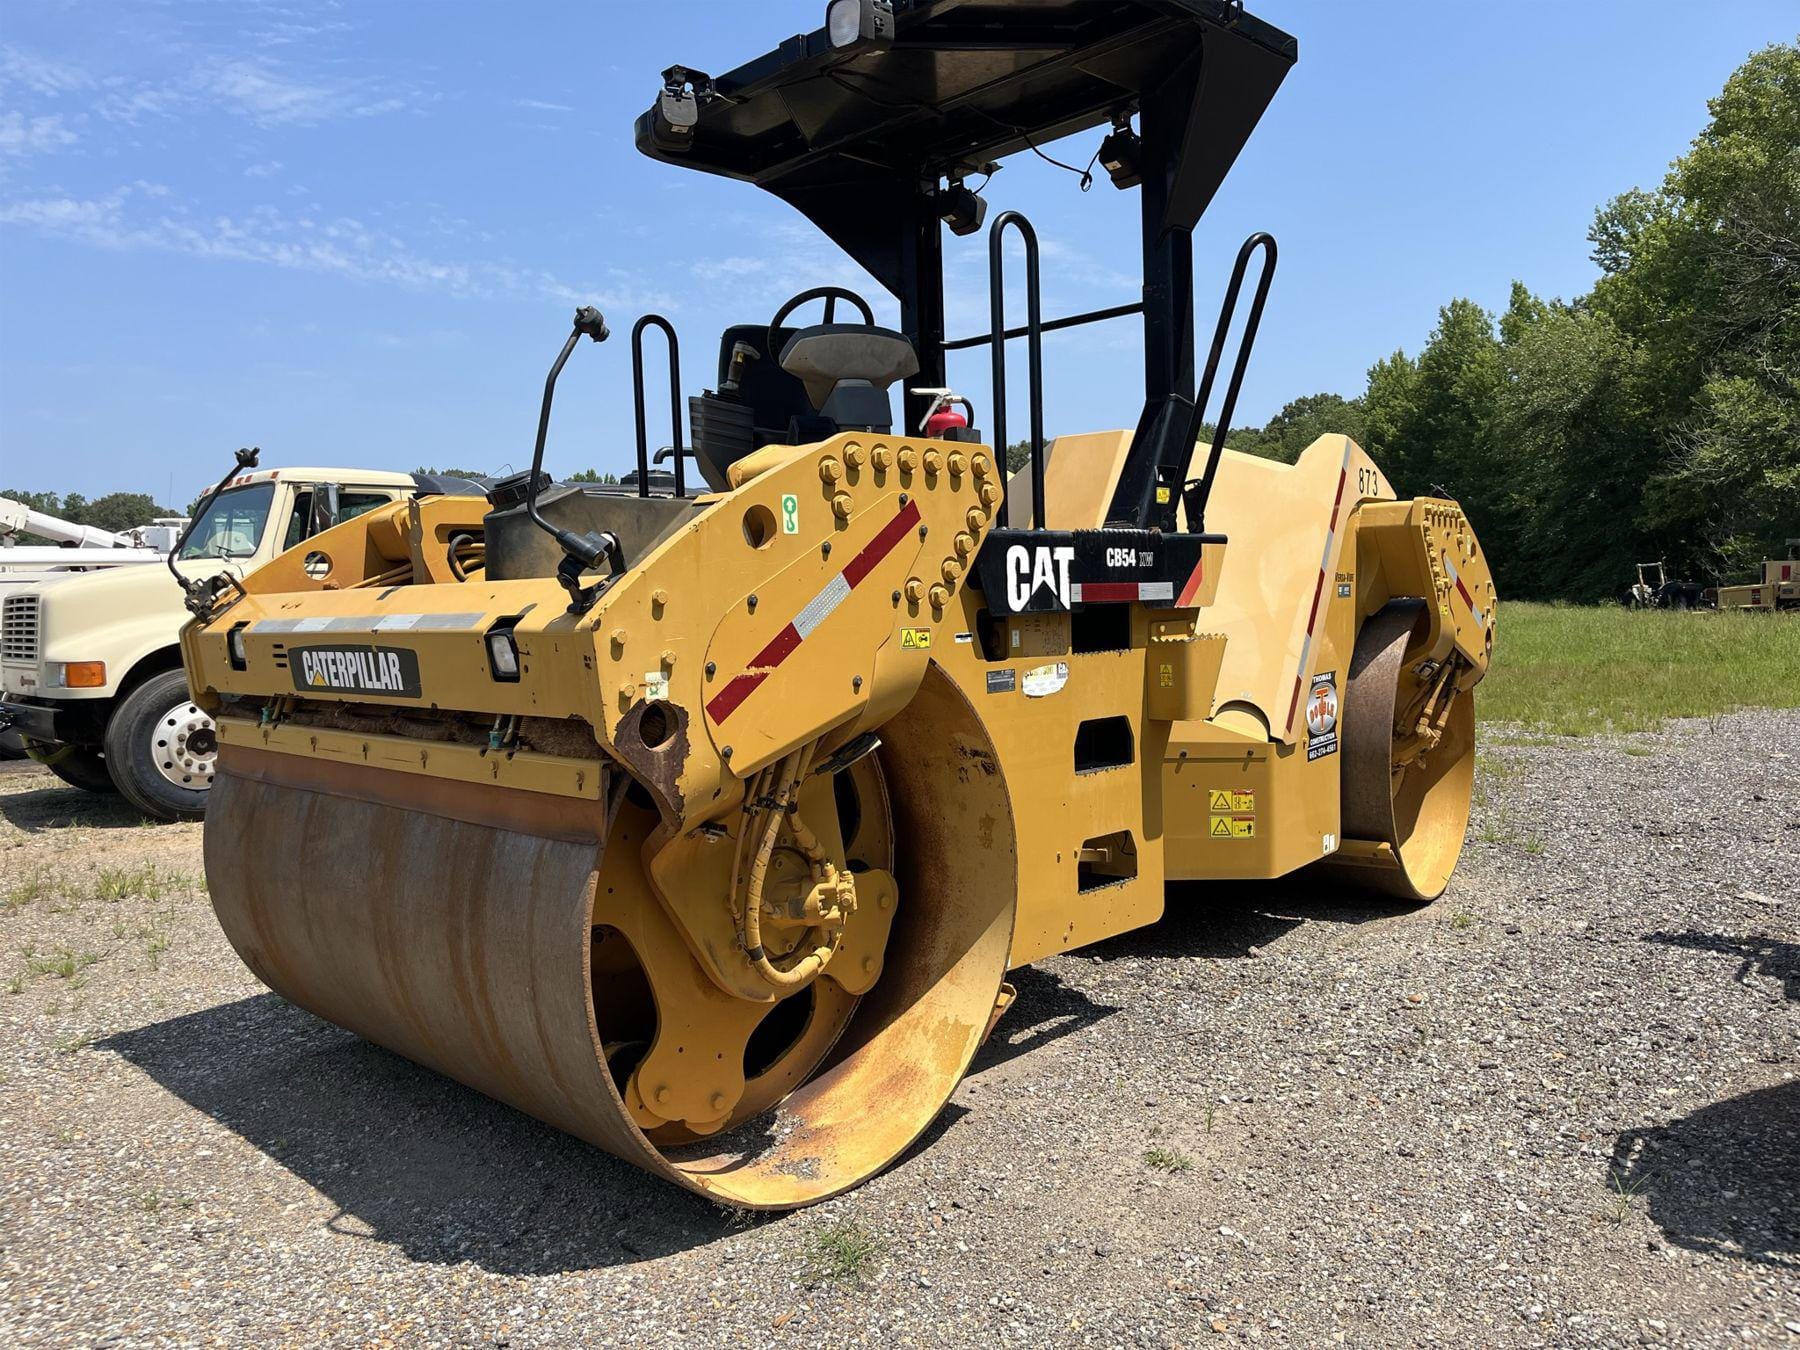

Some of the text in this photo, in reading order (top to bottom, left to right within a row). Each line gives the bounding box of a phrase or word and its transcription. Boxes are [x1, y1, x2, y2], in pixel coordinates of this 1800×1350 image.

[1359, 468, 1378, 496] 873
[1106, 548, 1137, 567] CB54
[1006, 544, 1075, 612] CAT
[302, 650, 404, 690] CATERPILLAR
[1313, 673, 1331, 683] THOMAS
[1310, 732, 1335, 746] CONSTRUCTION
